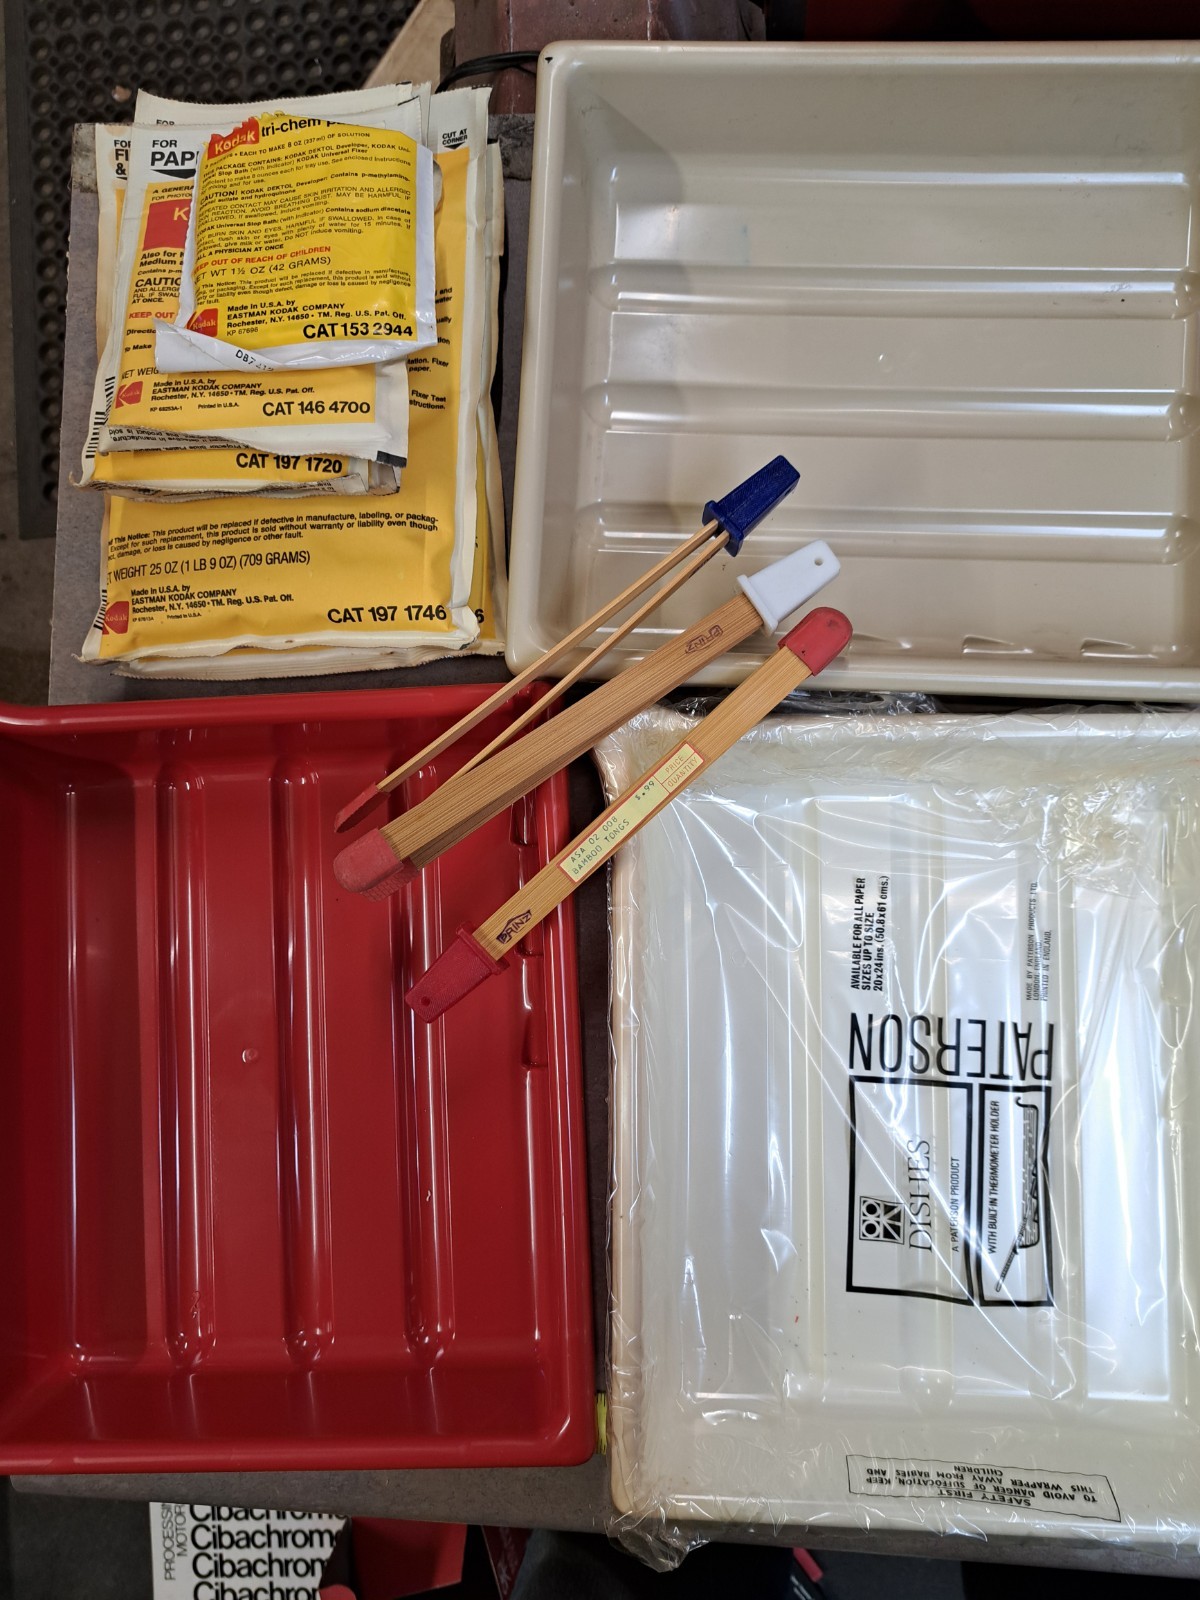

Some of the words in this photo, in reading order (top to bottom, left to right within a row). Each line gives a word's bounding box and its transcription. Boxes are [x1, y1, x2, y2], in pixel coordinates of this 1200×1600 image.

[442, 131, 457, 140] CUT
[459, 128, 468, 136] AT
[442, 135, 468, 146] CORNER
[152, 139, 178, 148] FOR
[215, 130, 256, 155] Kodak
[268, 144, 286, 152] MAKE
[150, 151, 199, 167] PAP
[115, 162, 127, 176] &
[139, 258, 176, 268] Medium
[141, 250, 160, 260] Also
[211, 258, 228, 266] OUT
[245, 256, 274, 264] REACH
[290, 246, 331, 258] CHILDREN
[210, 268, 227, 278] WT
[250, 266, 266, 274] OZ
[268, 263, 285, 274] (42
[288, 256, 331, 270] GRAMS)
[128, 311, 152, 320] KEEP
[154, 311, 176, 319] OUT
[226, 318, 268, 328] Rochester,
[270, 316, 284, 324] N.Y.
[287, 313, 310, 321] 14650
[334, 311, 352, 319] Reg.
[227, 311, 267, 320] EASTMAN
[270, 306, 298, 315] KODAK
[302, 303, 346, 312] COMPANY
[302, 322, 338, 339] CAT
[340, 322, 370, 336] 153
[373, 322, 414, 337] 2944
[432, 357, 449, 367] Fixer
[152, 386, 190, 394] EASTMAN
[192, 384, 220, 392] KODAK
[222, 382, 262, 390] COMPANY
[153, 380, 174, 388] Made
[150, 392, 189, 402] Rochester,
[411, 390, 429, 400] Fixer
[430, 394, 446, 402] Test
[262, 402, 294, 416] CAT
[298, 400, 325, 414] 146
[328, 401, 370, 414] 4700
[236, 452, 270, 469] CAT
[274, 454, 301, 470] 197
[304, 456, 342, 474] 1720
[168, 526, 194, 536] product
[220, 520, 252, 530] replaced
[260, 516, 294, 525] defective
[305, 512, 357, 522] manufacture,
[358, 512, 392, 520] labeling,
[406, 512, 438, 524] packag-
[142, 538, 158, 546] such
[159, 534, 204, 544] replacement,
[221, 528, 250, 538] product
[260, 524, 276, 533] sold
[278, 522, 307, 532] without
[310, 521, 344, 532] warranty
[357, 520, 384, 528] liability
[410, 520, 438, 532] though
[174, 540, 200, 550] caused
[212, 536, 252, 546] negligence
[262, 532, 282, 541] other
[284, 531, 304, 539] fault.
[114, 564, 148, 582] WEIGHT
[150, 562, 162, 576] 25
[164, 560, 179, 574] OZ
[193, 558, 207, 572] LB
[210, 557, 216, 570] 9
[218, 556, 237, 570] OZ)
[240, 553, 262, 570] (709
[265, 550, 310, 566] GRAMS)
[130, 588, 148, 596] Made
[131, 596, 166, 606] EASTMAN
[168, 592, 196, 602] KODAK
[196, 588, 237, 599] COMPANY
[132, 604, 168, 614] Rochester,
[186, 600, 207, 610] 14650
[327, 606, 364, 624] CAT
[368, 606, 398, 622] 197
[404, 604, 448, 622] 1746
[664, 755, 684, 774] PRICE
[667, 756, 698, 788] QUANTITY
[570, 846, 586, 864] ASA
[602, 816, 618, 832] 008
[572, 844, 603, 875] BAMBOO
[604, 818, 630, 844] TONGS
[854, 878, 866, 904] PAPER
[879, 876, 890, 900] cms.)
[854, 906, 864, 922] ALL
[497, 910, 532, 944] PRINZ
[864, 912, 874, 933] SIZE
[853, 924, 863, 940] FOR
[864, 935, 874, 946] TO
[863, 948, 873, 961] UP
[850, 943, 862, 990] AVAILABLE
[862, 964, 872, 991] SIZES
[848, 1012, 1055, 1082] PATERSON
[990, 1100, 1001, 1132] HOLDER
[988, 1134, 1000, 1196] THERMOMETER
[950, 1156, 960, 1196] PRODUCT
[906, 1139, 932, 1254] DISHES
[950, 1198, 960, 1244] PATERSON
[951, 1245, 960, 1253] A
[988, 1232, 997, 1255] WITH
[866, 1468, 887, 1476] AND
[895, 1469, 930, 1478] BABIES
[936, 1470, 964, 1480] FROM
[954, 1465, 1004, 1477] CHILDREN
[866, 1476, 891, 1486] KEEP
[895, 1476, 966, 1489] SUFFOCATION,
[972, 1474, 1002, 1485] AWAY
[974, 1482, 986, 1492] OF
[1010, 1478, 1062, 1491] WRAPPER
[937, 1489, 974, 1499] FIRST
[992, 1484, 1036, 1498] DANGER
[1042, 1490, 1076, 1501] AVOID
[1070, 1484, 1096, 1494] THIS
[980, 1492, 1032, 1506] SAFETY
[1083, 1494, 1098, 1503] TO
[190, 1524, 337, 1550] Cibachrom
